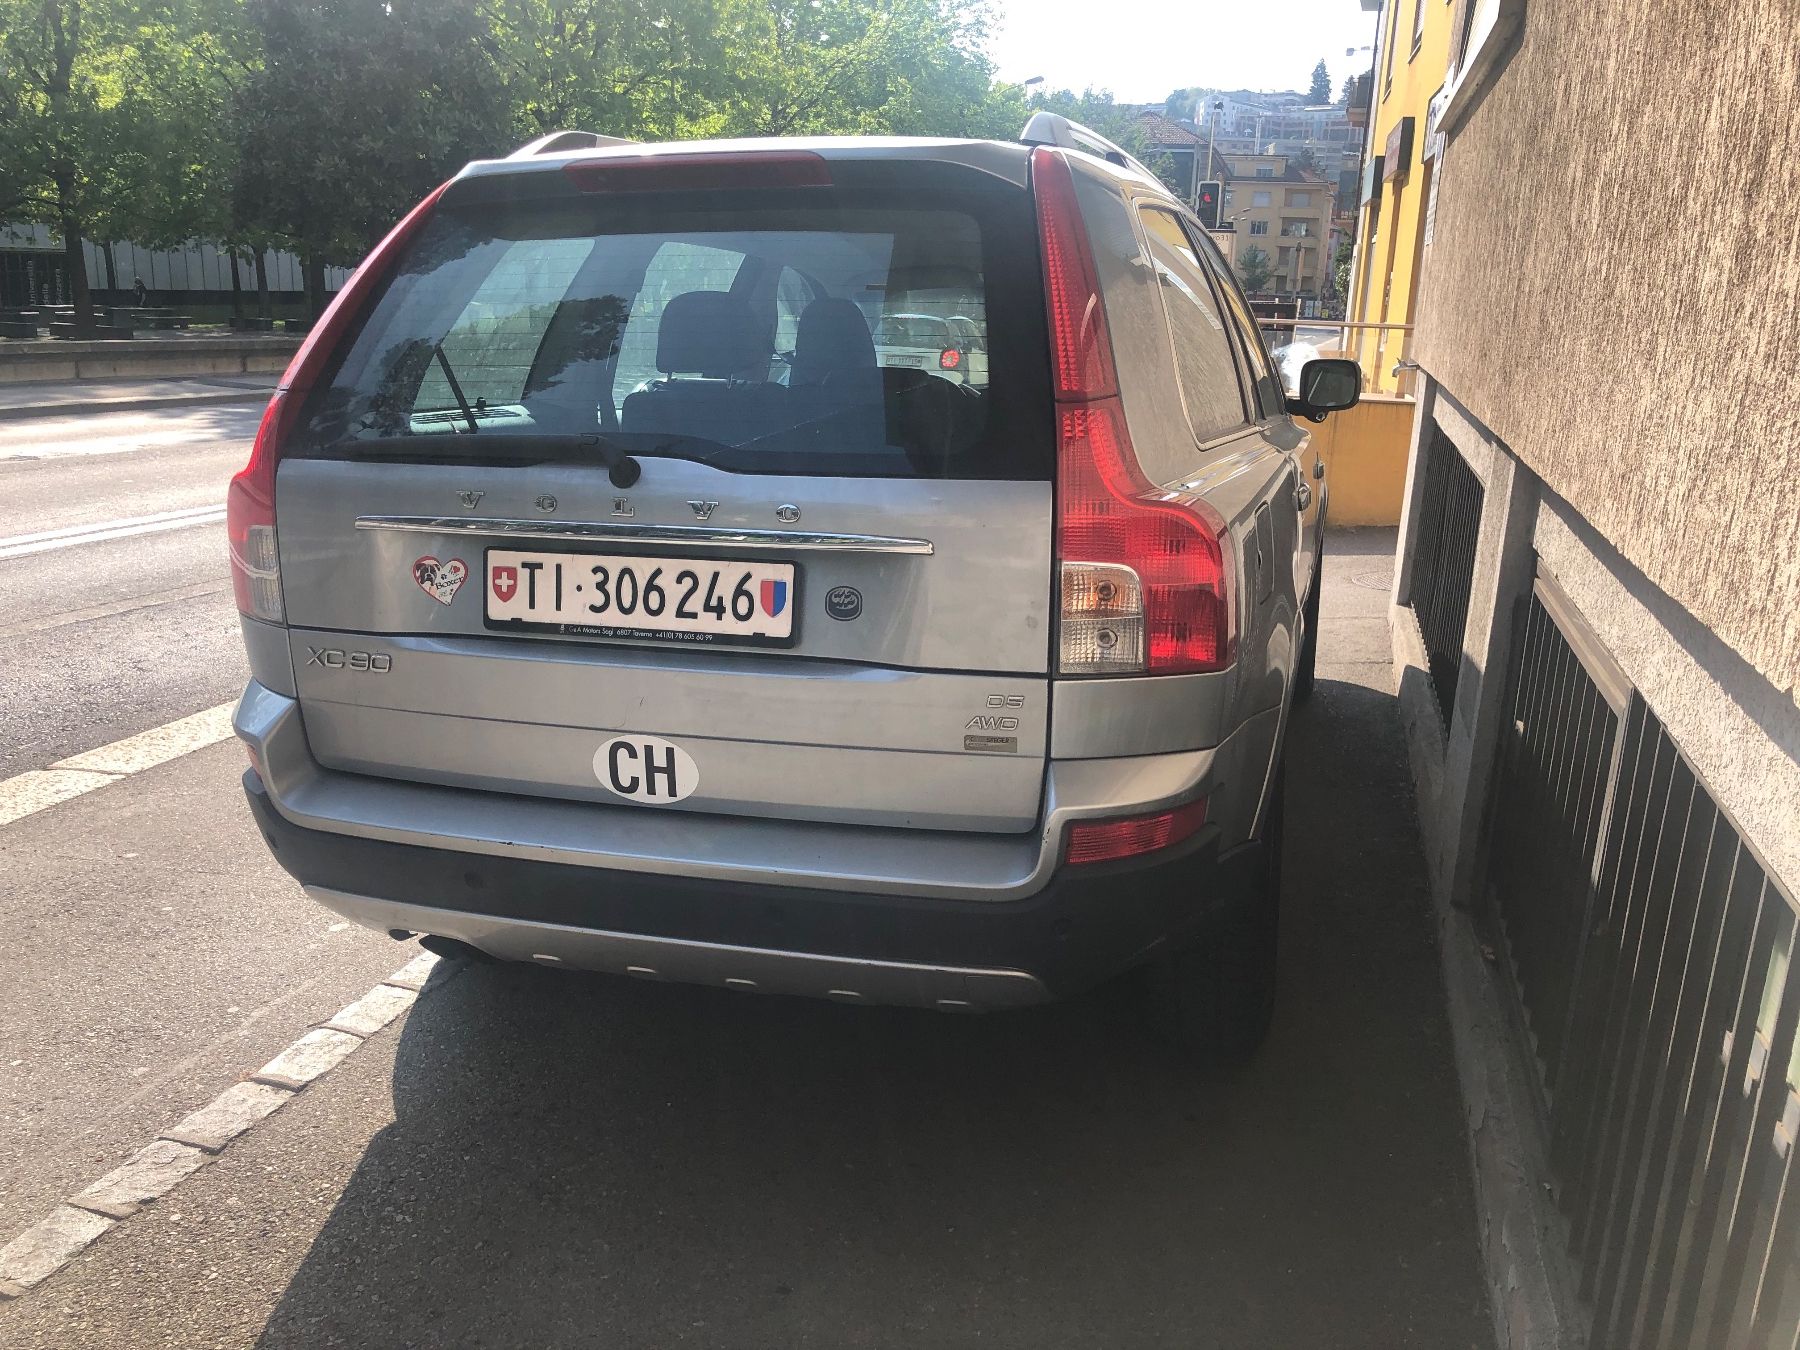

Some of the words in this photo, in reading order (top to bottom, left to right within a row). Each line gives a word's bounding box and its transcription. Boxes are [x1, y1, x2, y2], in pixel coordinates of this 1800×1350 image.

[456, 490, 801, 523] VOLVO
[986, 695, 1024, 709] D5
[965, 716, 1019, 731] AWD
[609, 741, 677, 797] CH
